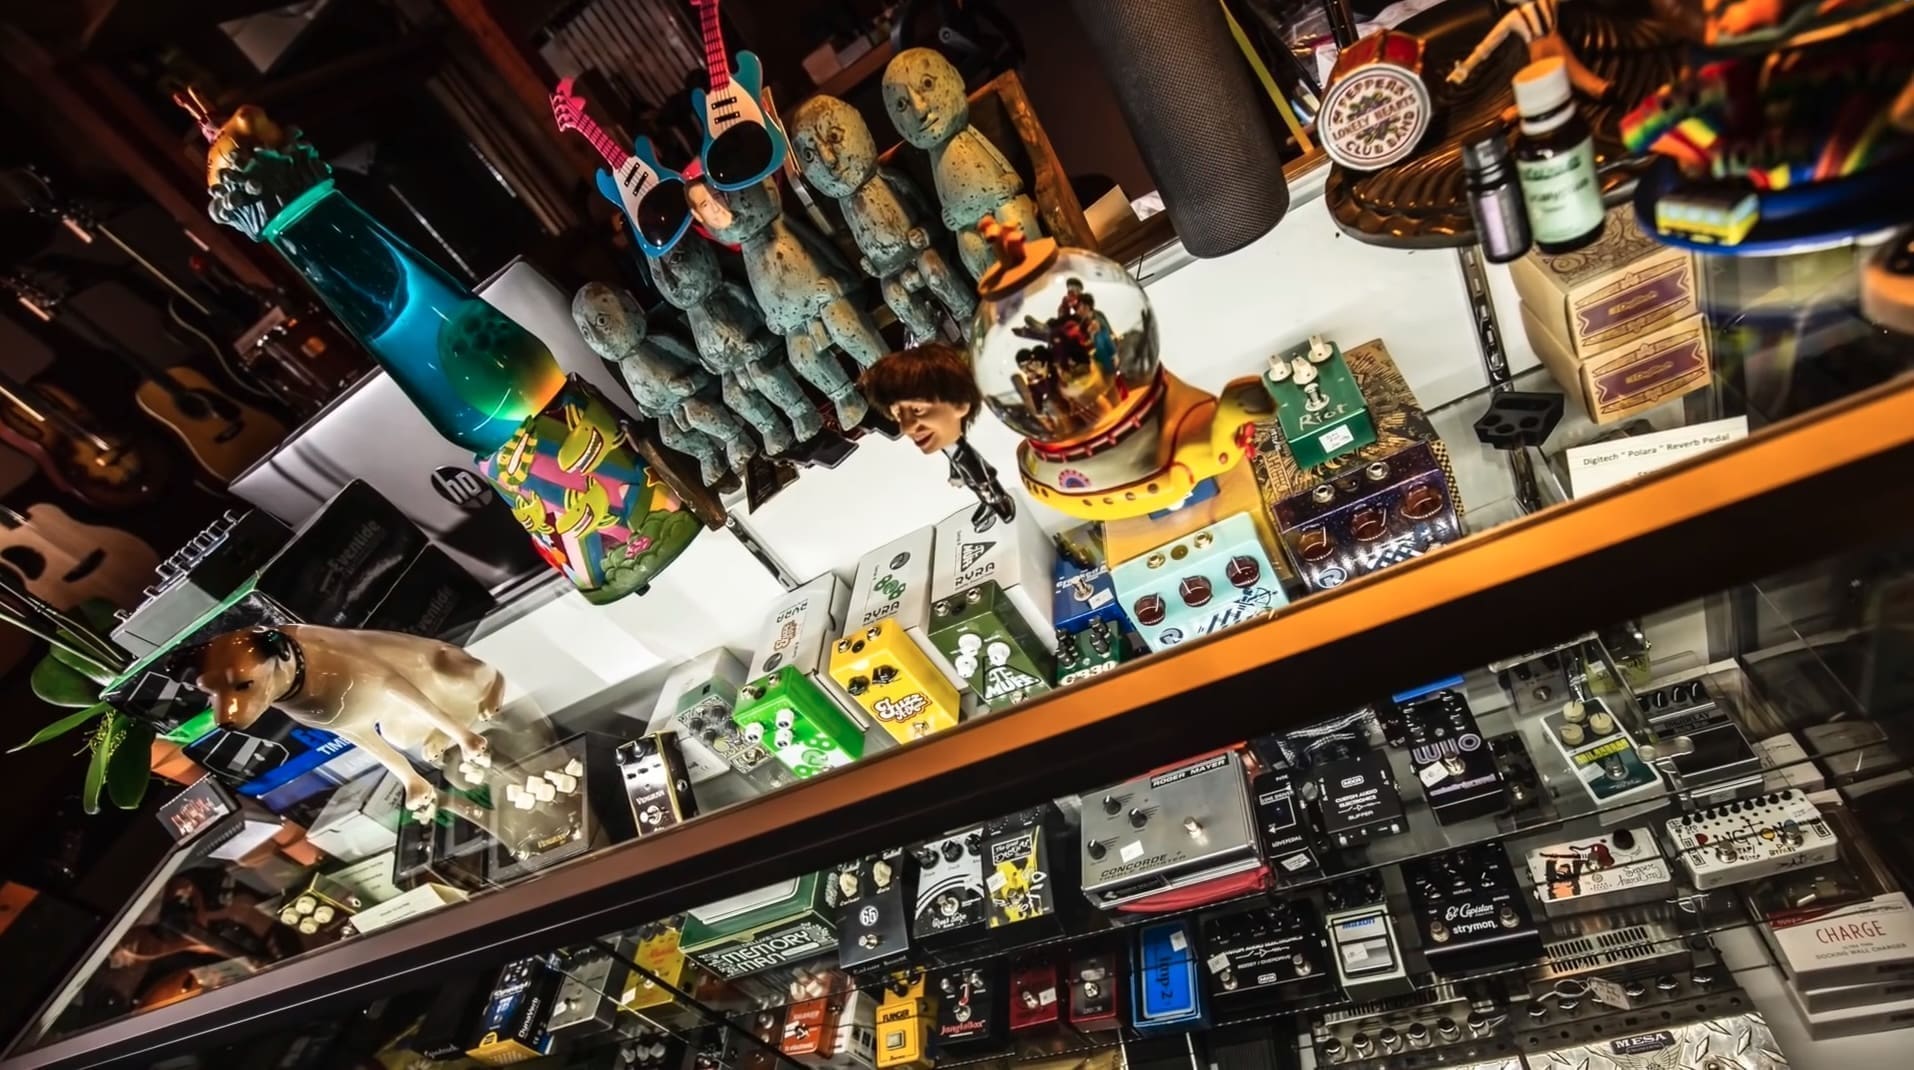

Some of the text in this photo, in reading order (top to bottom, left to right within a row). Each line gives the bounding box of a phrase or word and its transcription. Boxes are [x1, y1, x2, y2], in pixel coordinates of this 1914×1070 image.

[1345, 140, 1384, 156] CLUB
[1299, 403, 1348, 431] Riot
[1583, 451, 1619, 466] Digitech
[1628, 446, 1657, 457] Polara
[1666, 440, 1700, 451] Reverb
[1702, 433, 1730, 445] Pedal
[1152, 759, 1226, 788] ROGER MAYER
[1100, 853, 1168, 878] CONCORDE
[1452, 920, 1497, 935] strymon
[1815, 920, 1887, 944] CHARGE
[721, 929, 813, 964] MEMORY
[737, 953, 788, 972] MAN
[517, 997, 540, 1039] DynaVerb
[1615, 1032, 1667, 1049] MESA
